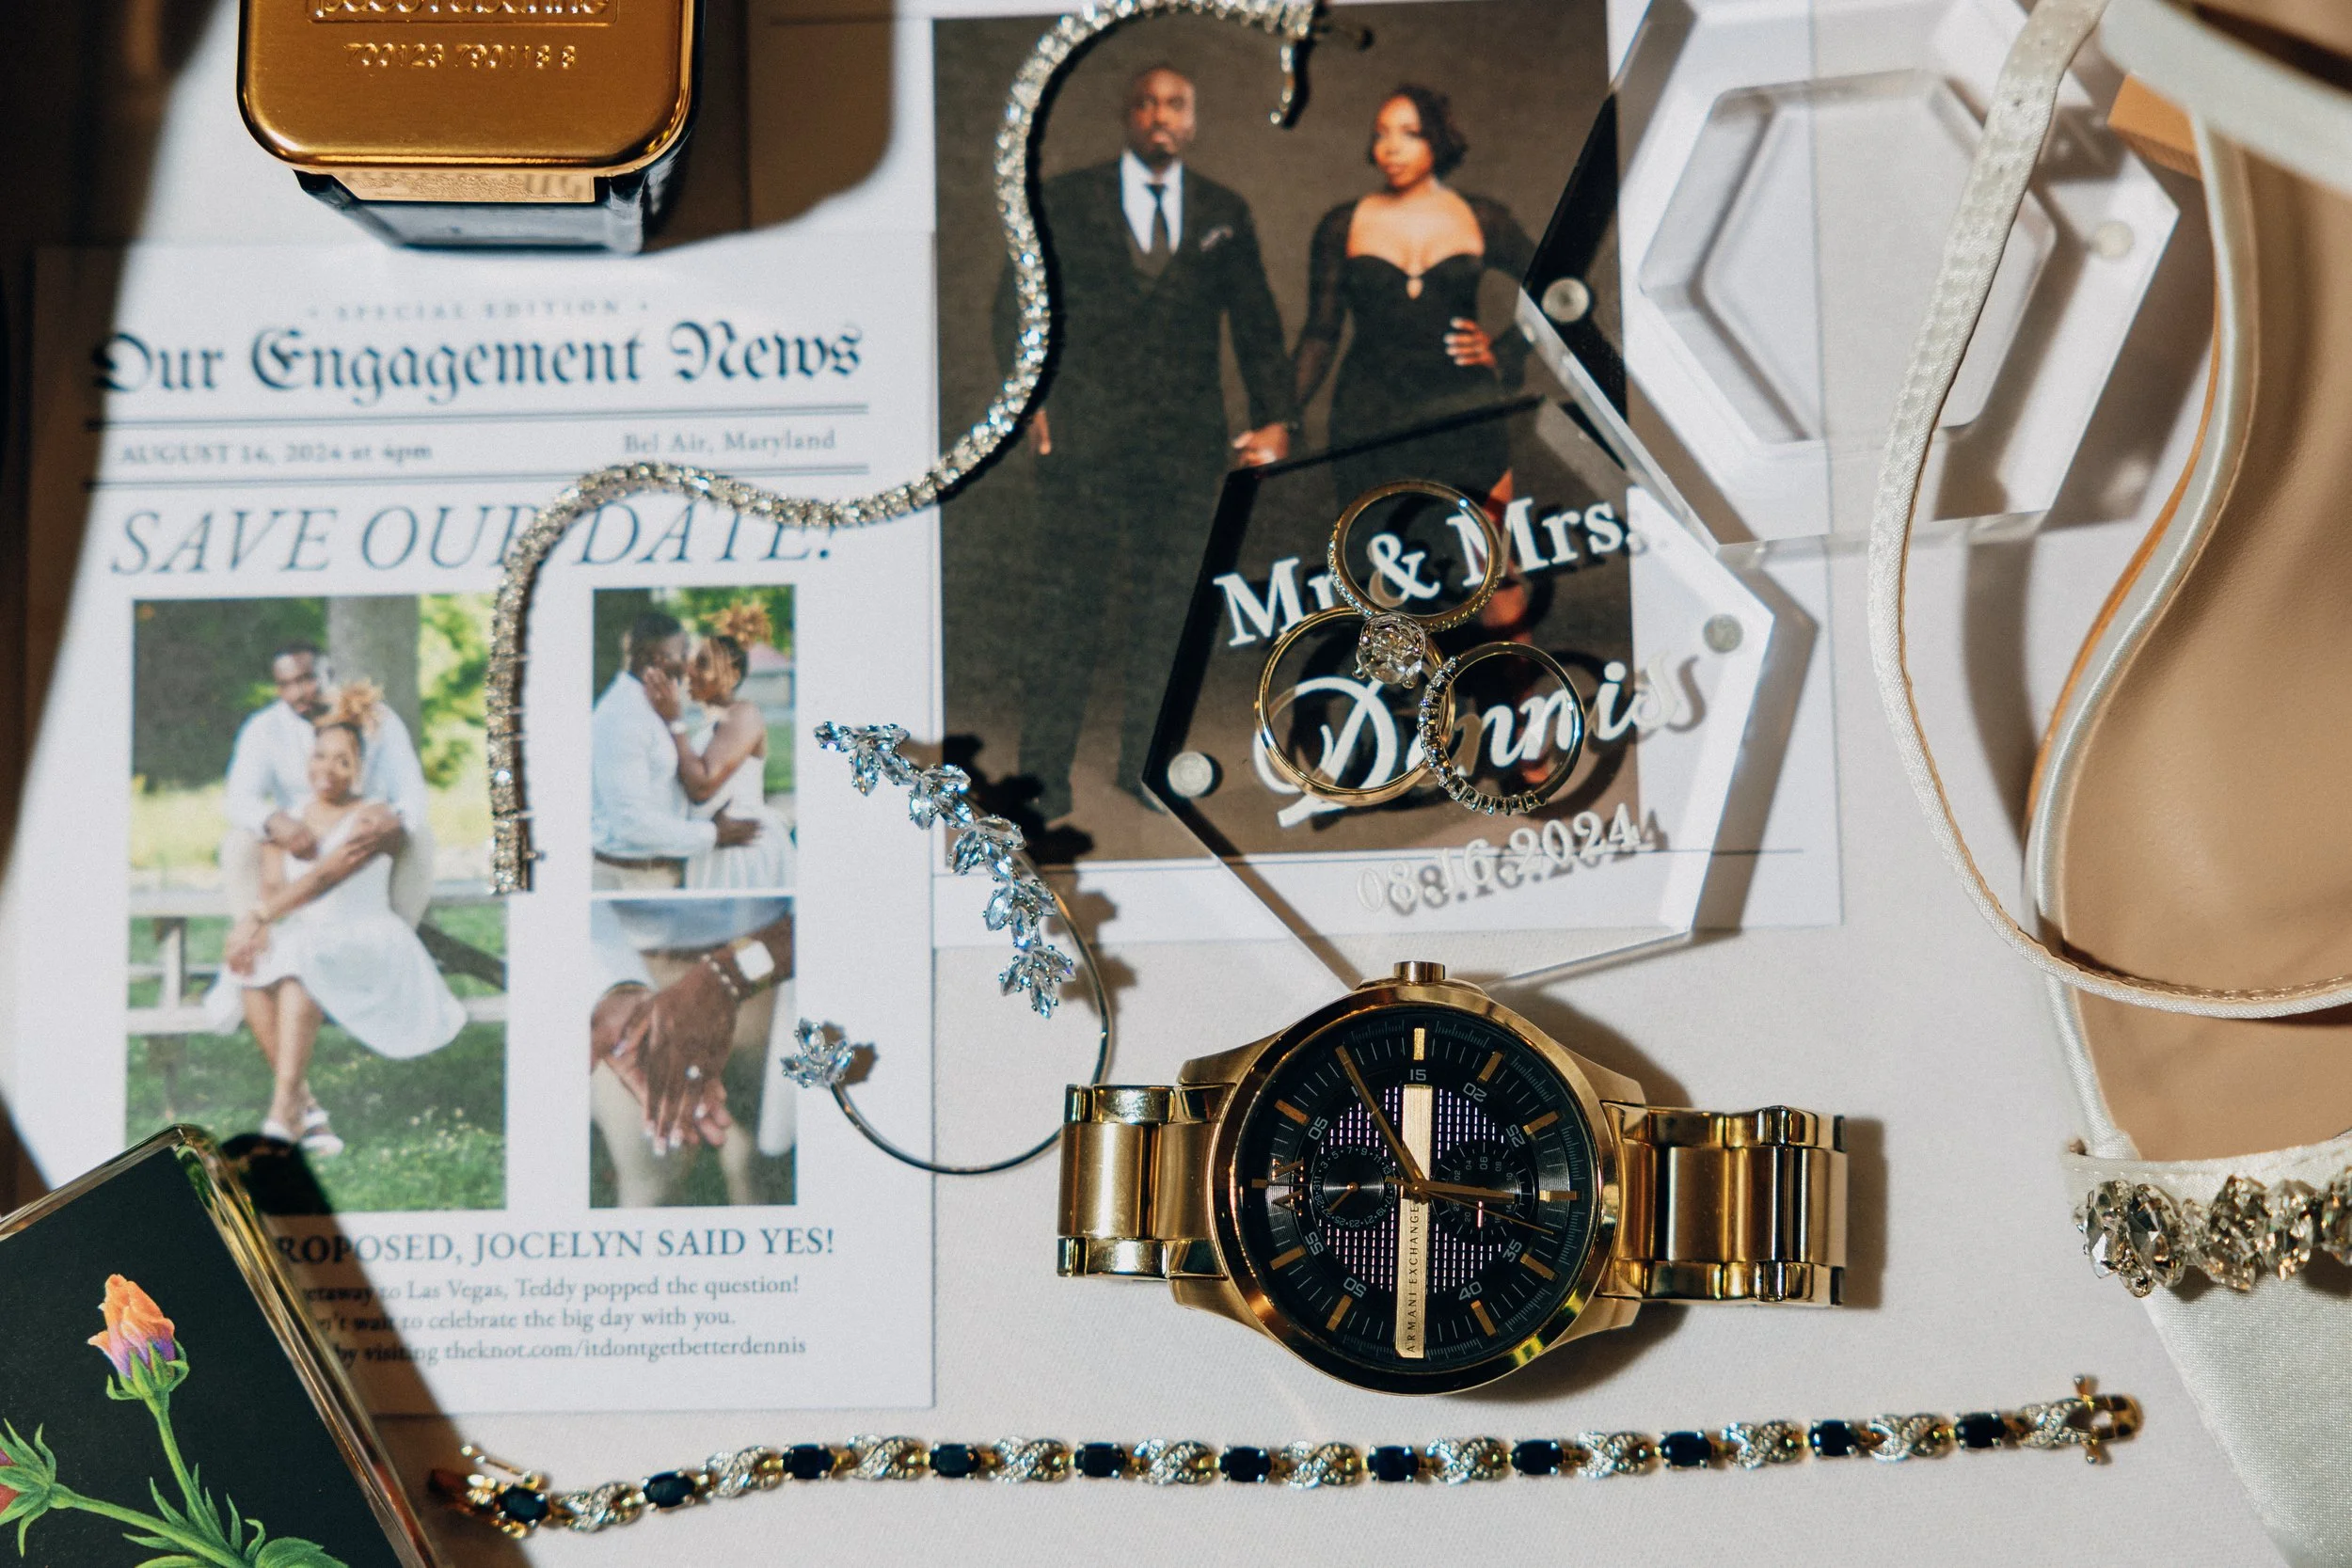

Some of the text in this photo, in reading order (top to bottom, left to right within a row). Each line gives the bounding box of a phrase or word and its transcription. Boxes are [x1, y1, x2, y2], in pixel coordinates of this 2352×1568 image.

[336, 300, 620, 321] SPECIAL EDITION
[92, 320, 864, 406] Our Engagement News
[123, 443, 230, 466] AUGUST
[285, 442, 342, 463] 2024
[624, 428, 836, 457] Bel Air, Maryland
[109, 506, 339, 577] SAVE
[1366, 532, 1442, 605] &
[1409, 1069, 1426, 1082] 15
[276, 1227, 834, 1267] ROPOSED, JOCELYN SAID YES!
[378, 1283, 401, 1299] to
[407, 1279, 441, 1299] Las
[447, 1278, 509, 1305] Vegas,
[516, 1277, 577, 1303] Teddy
[583, 1275, 660, 1303] popped
[666, 1275, 698, 1295] the
[704, 1274, 800, 1301] question!
[1406, 1205, 1420, 1354] ARMANI EXCHANGE
[429, 1308, 519, 1329] celebrate
[524, 1307, 557, 1327] the
[561, 1307, 595, 1333] big
[599, 1307, 634, 1333] day
[641, 1306, 687, 1325] with
[693, 1311, 737, 1332] you.
